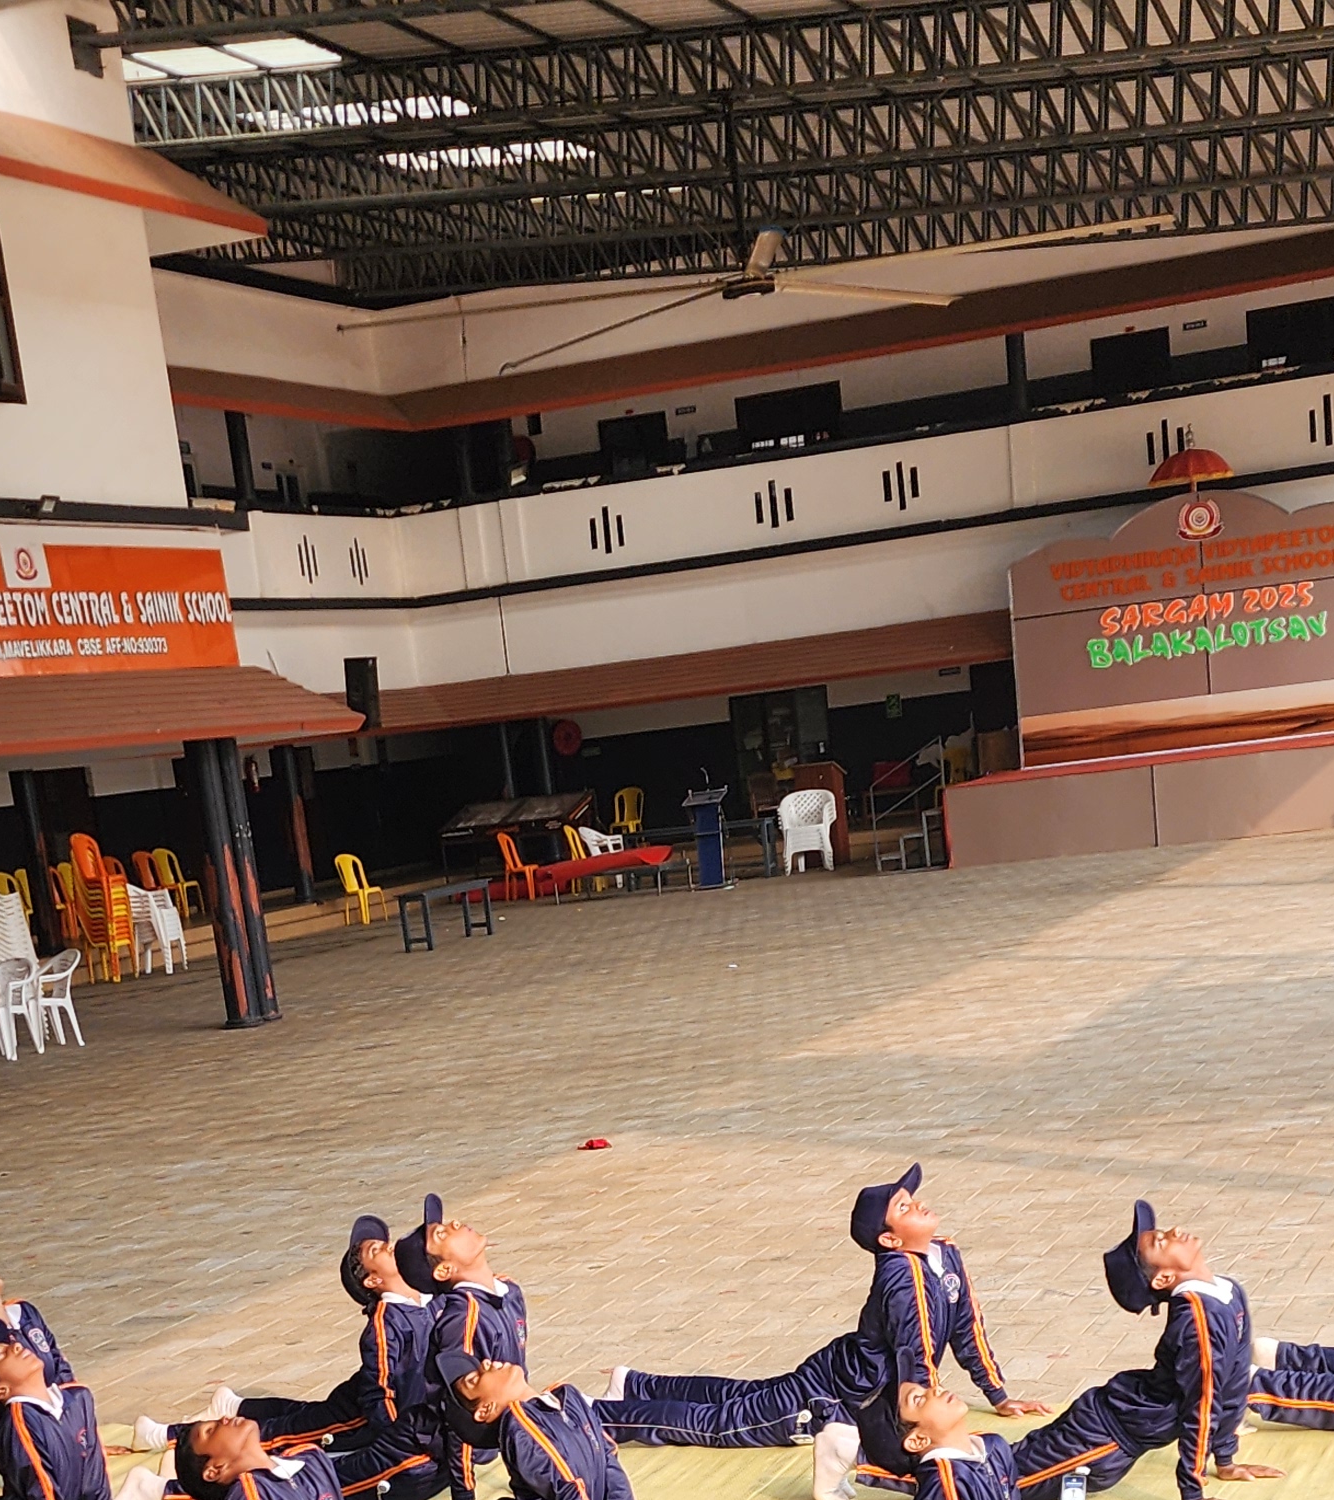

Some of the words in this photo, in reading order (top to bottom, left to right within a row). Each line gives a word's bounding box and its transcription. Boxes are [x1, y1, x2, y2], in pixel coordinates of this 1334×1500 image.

[1060, 574, 1153, 602] CENTRAL
[1162, 571, 1177, 588] &
[1184, 560, 1255, 586] SAINIK
[51, 591, 120, 628] CENTRAL
[120, 591, 135, 624] &
[135, 591, 184, 627] SAINIK
[183, 591, 233, 626] SCHOOL
[1099, 592, 1235, 637] SARGAM
[1241, 581, 1315, 614] 2025
[77, 637, 103, 656] CBSE
[1086, 610, 1328, 669] BALAKALOTSAV
